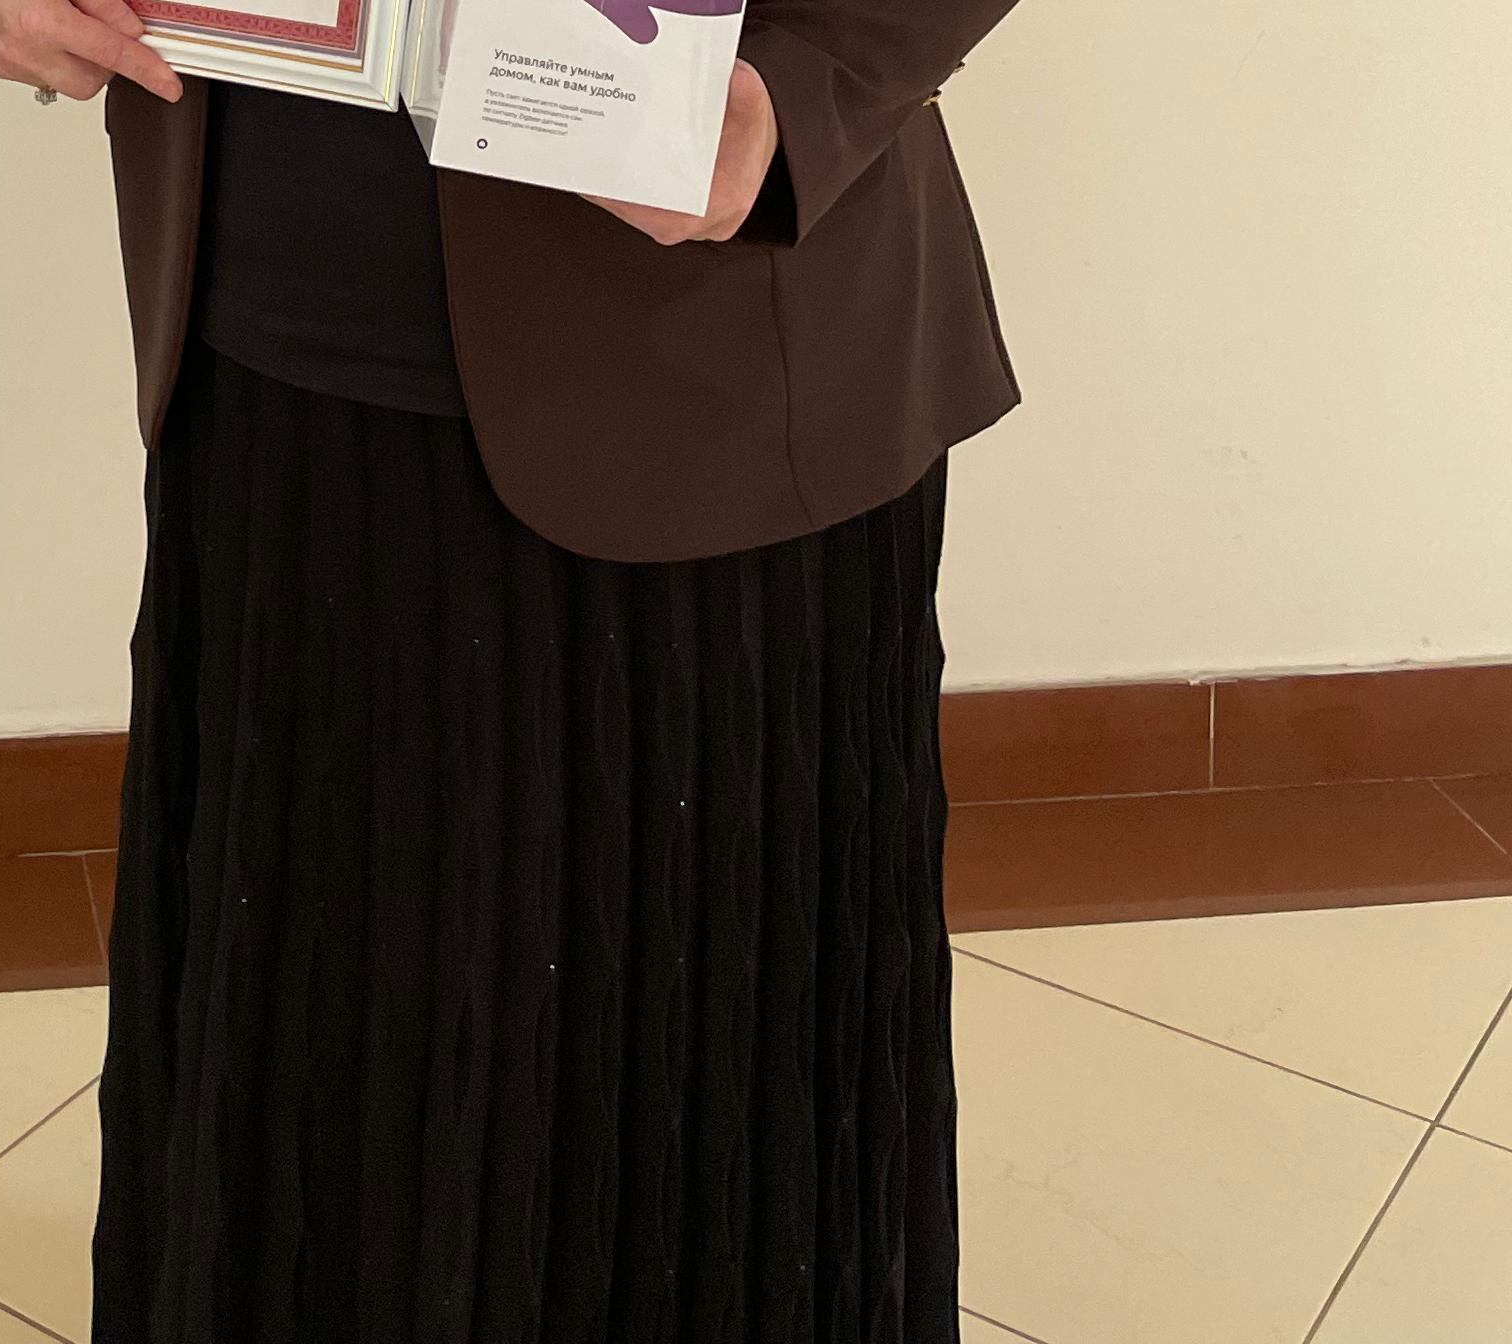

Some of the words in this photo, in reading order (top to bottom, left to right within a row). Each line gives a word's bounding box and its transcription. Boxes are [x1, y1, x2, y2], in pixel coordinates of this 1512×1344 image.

[493, 48, 568, 73] Управляйте
[570, 64, 615, 82] умным
[489, 66, 537, 84] домом,
[539, 75, 561, 88] как
[563, 80, 588, 93] вам
[589, 85, 637, 103] удобно
